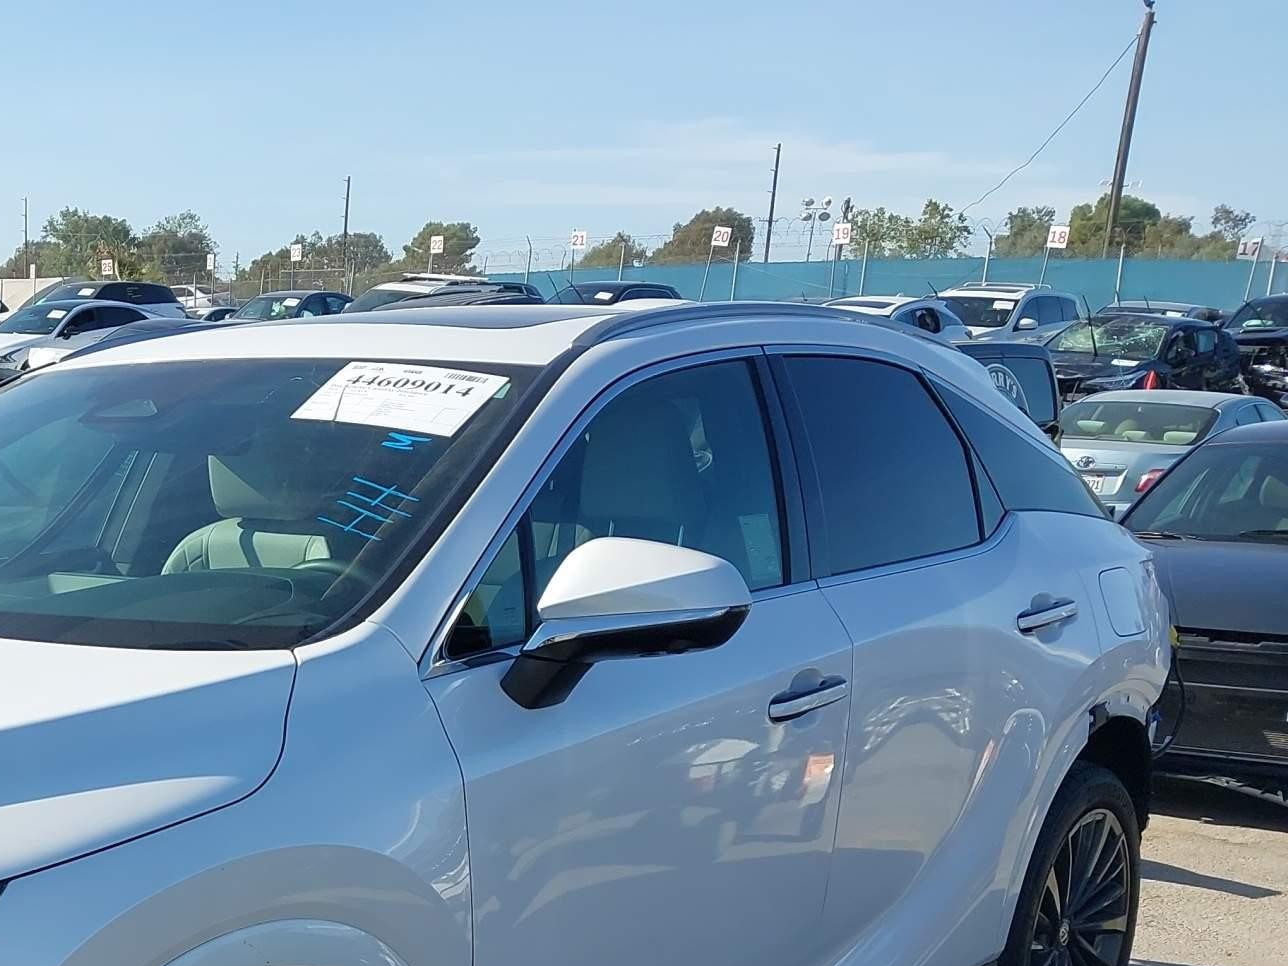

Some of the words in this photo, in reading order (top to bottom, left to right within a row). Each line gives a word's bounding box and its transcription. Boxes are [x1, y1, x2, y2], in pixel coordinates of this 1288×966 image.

[572, 234, 585, 246] 21
[713, 230, 729, 243] 20
[834, 227, 850, 240] 19
[1048, 230, 1066, 244] 18
[432, 239, 443, 250] 22
[1239, 241, 1260, 256] 17
[292, 248, 301, 258] 23
[102, 262, 113, 273] 25
[346, 373, 476, 398] 44609014
